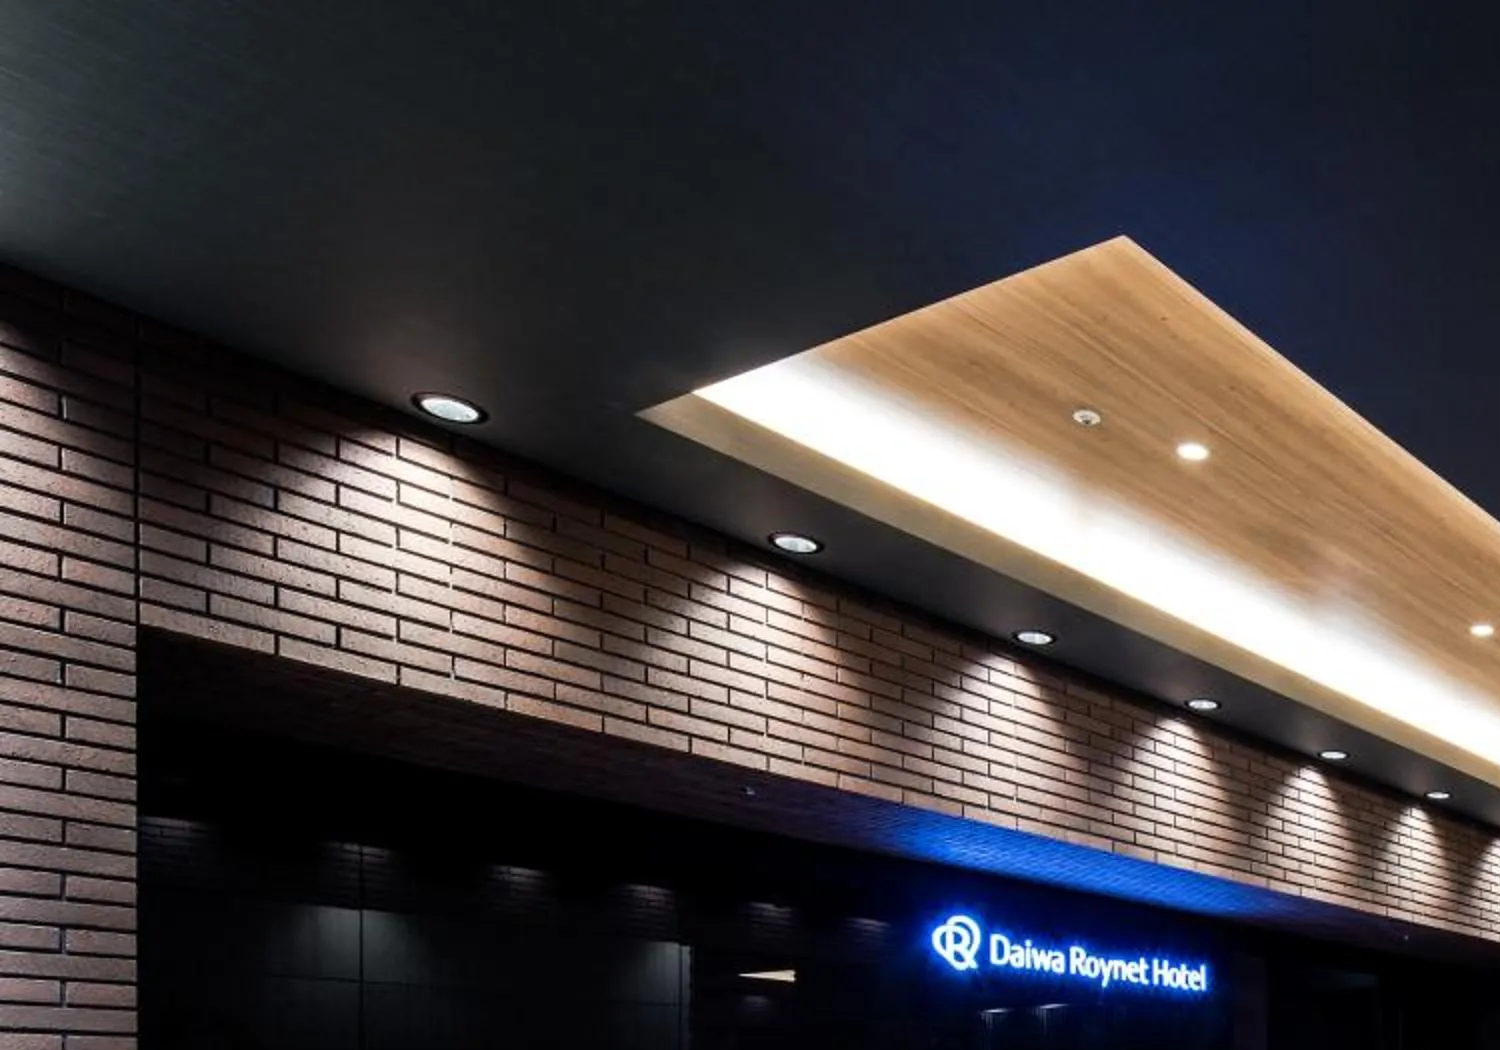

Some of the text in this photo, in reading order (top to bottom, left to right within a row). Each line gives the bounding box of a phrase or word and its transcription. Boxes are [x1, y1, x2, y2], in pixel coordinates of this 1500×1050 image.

[989, 933, 1207, 991] Daiwa Roynet Hotel
